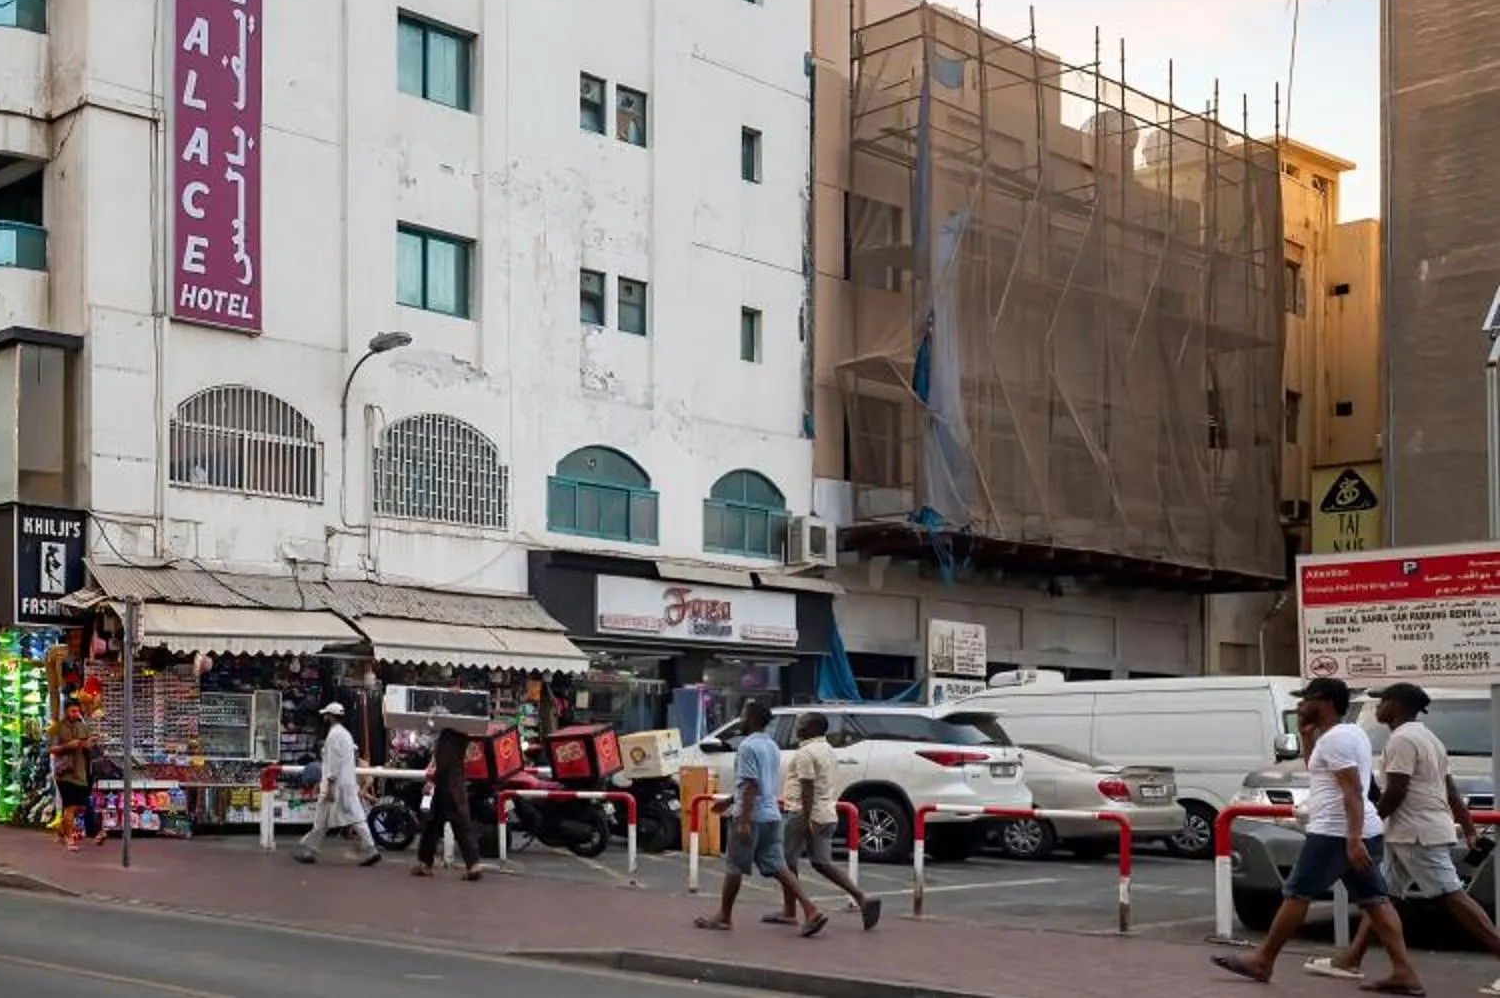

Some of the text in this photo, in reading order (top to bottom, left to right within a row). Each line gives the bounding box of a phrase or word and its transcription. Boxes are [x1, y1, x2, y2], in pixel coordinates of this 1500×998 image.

[179, 283, 254, 320] HOTEL
[23, 517, 81, 538] KHILJI'S
[1338, 512, 1361, 536] TAJ
[1403, 561, 1418, 575] P
[1409, 610, 1447, 621] PARKING
